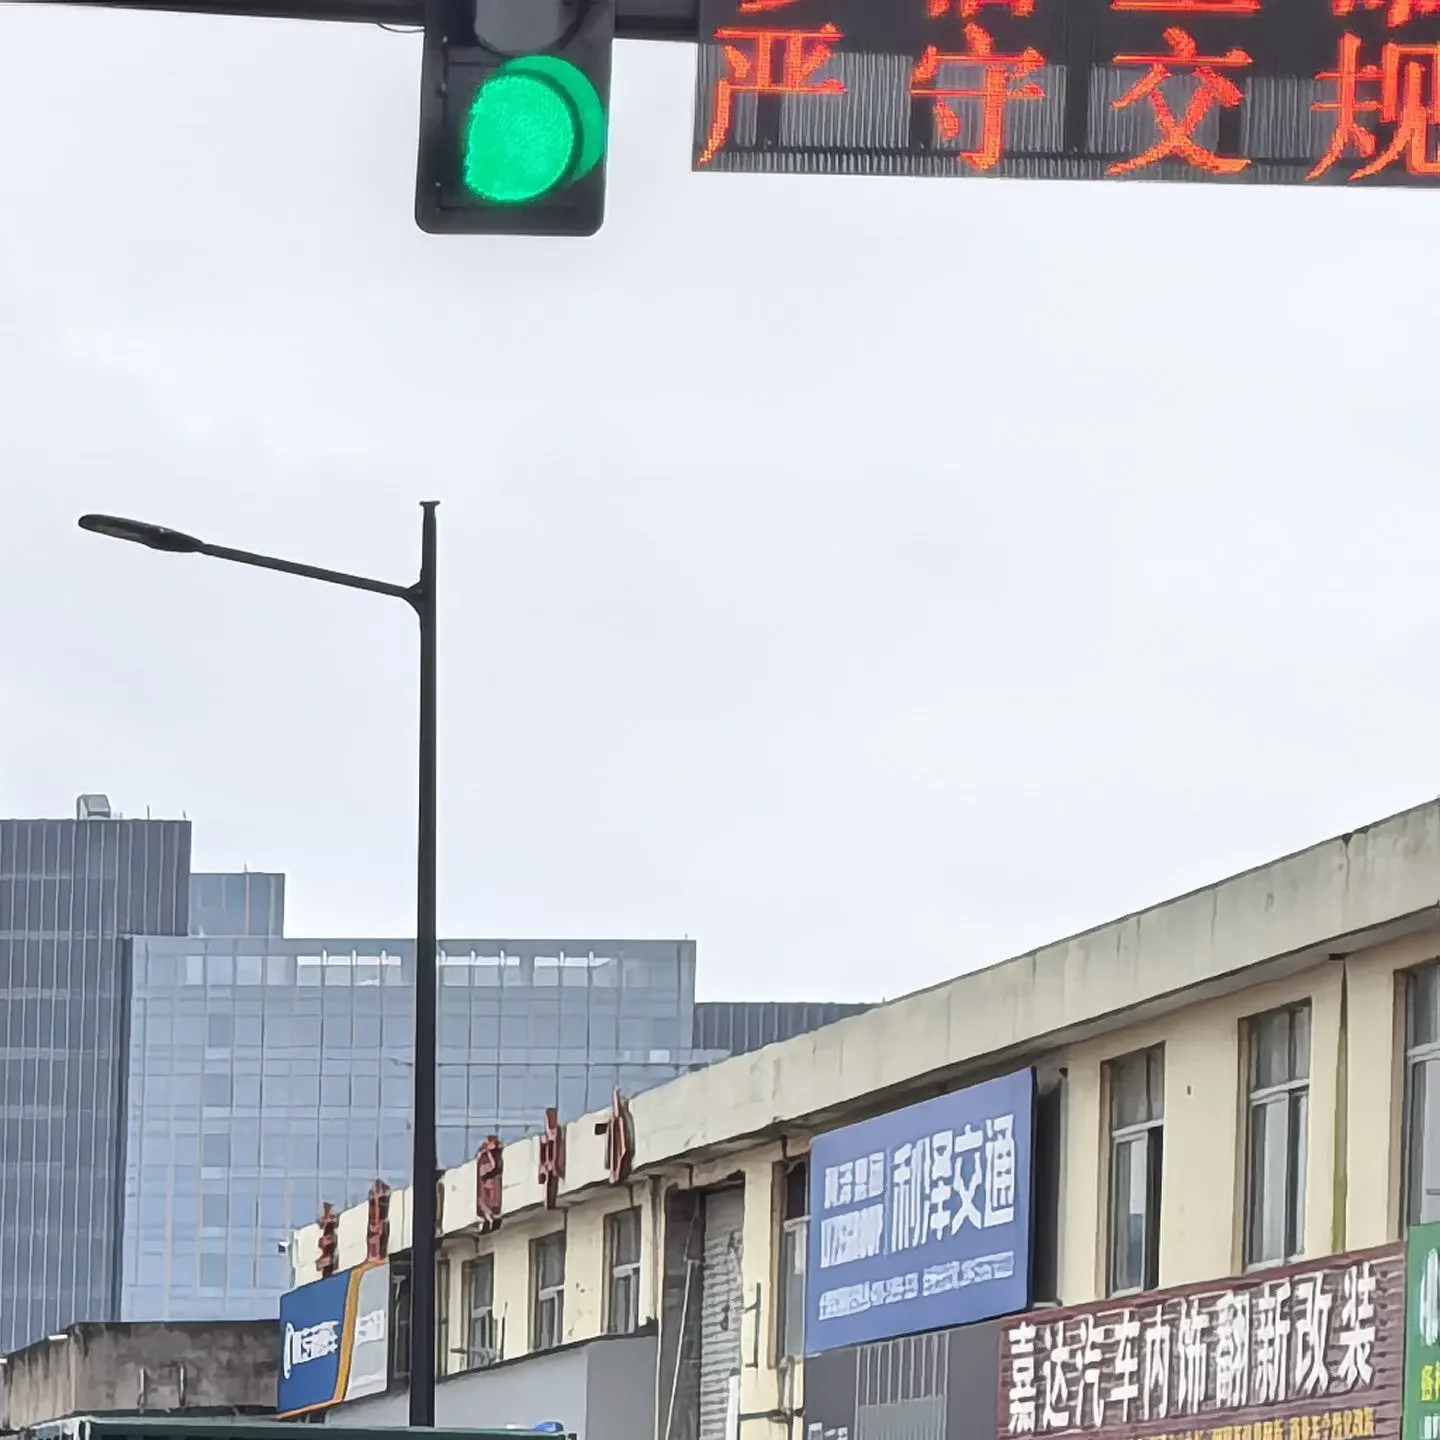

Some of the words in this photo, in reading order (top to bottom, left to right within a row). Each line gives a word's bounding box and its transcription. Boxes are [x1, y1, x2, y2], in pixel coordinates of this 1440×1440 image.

[697, 22, 1440, 181] 严守交规
[1008, 1260, 1377, 1434] 嘉达汽车内饰翻新改装
